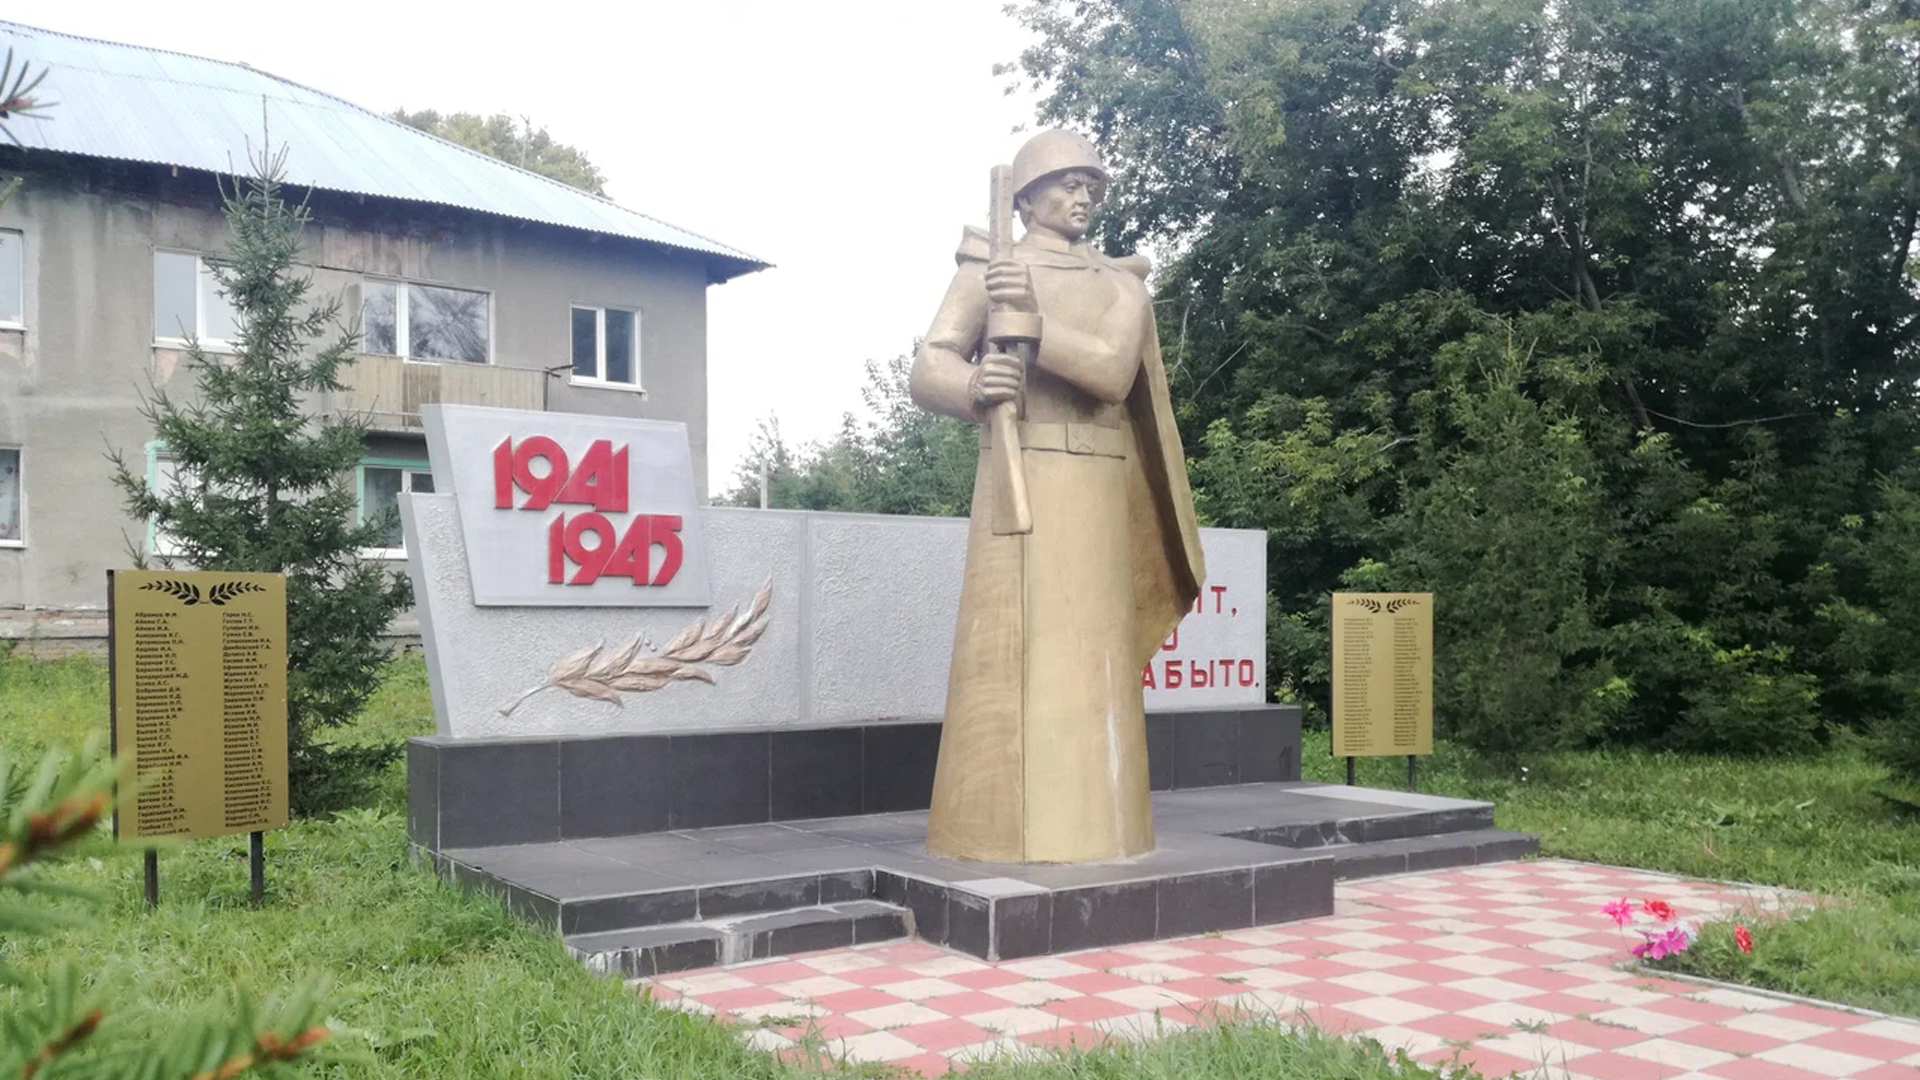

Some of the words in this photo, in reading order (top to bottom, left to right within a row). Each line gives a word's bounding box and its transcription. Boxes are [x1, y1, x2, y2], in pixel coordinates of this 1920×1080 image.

[493, 434, 629, 513] 1941
[547, 511, 683, 587] 1945
[1141, 659, 1260, 689] АБЫТО.
